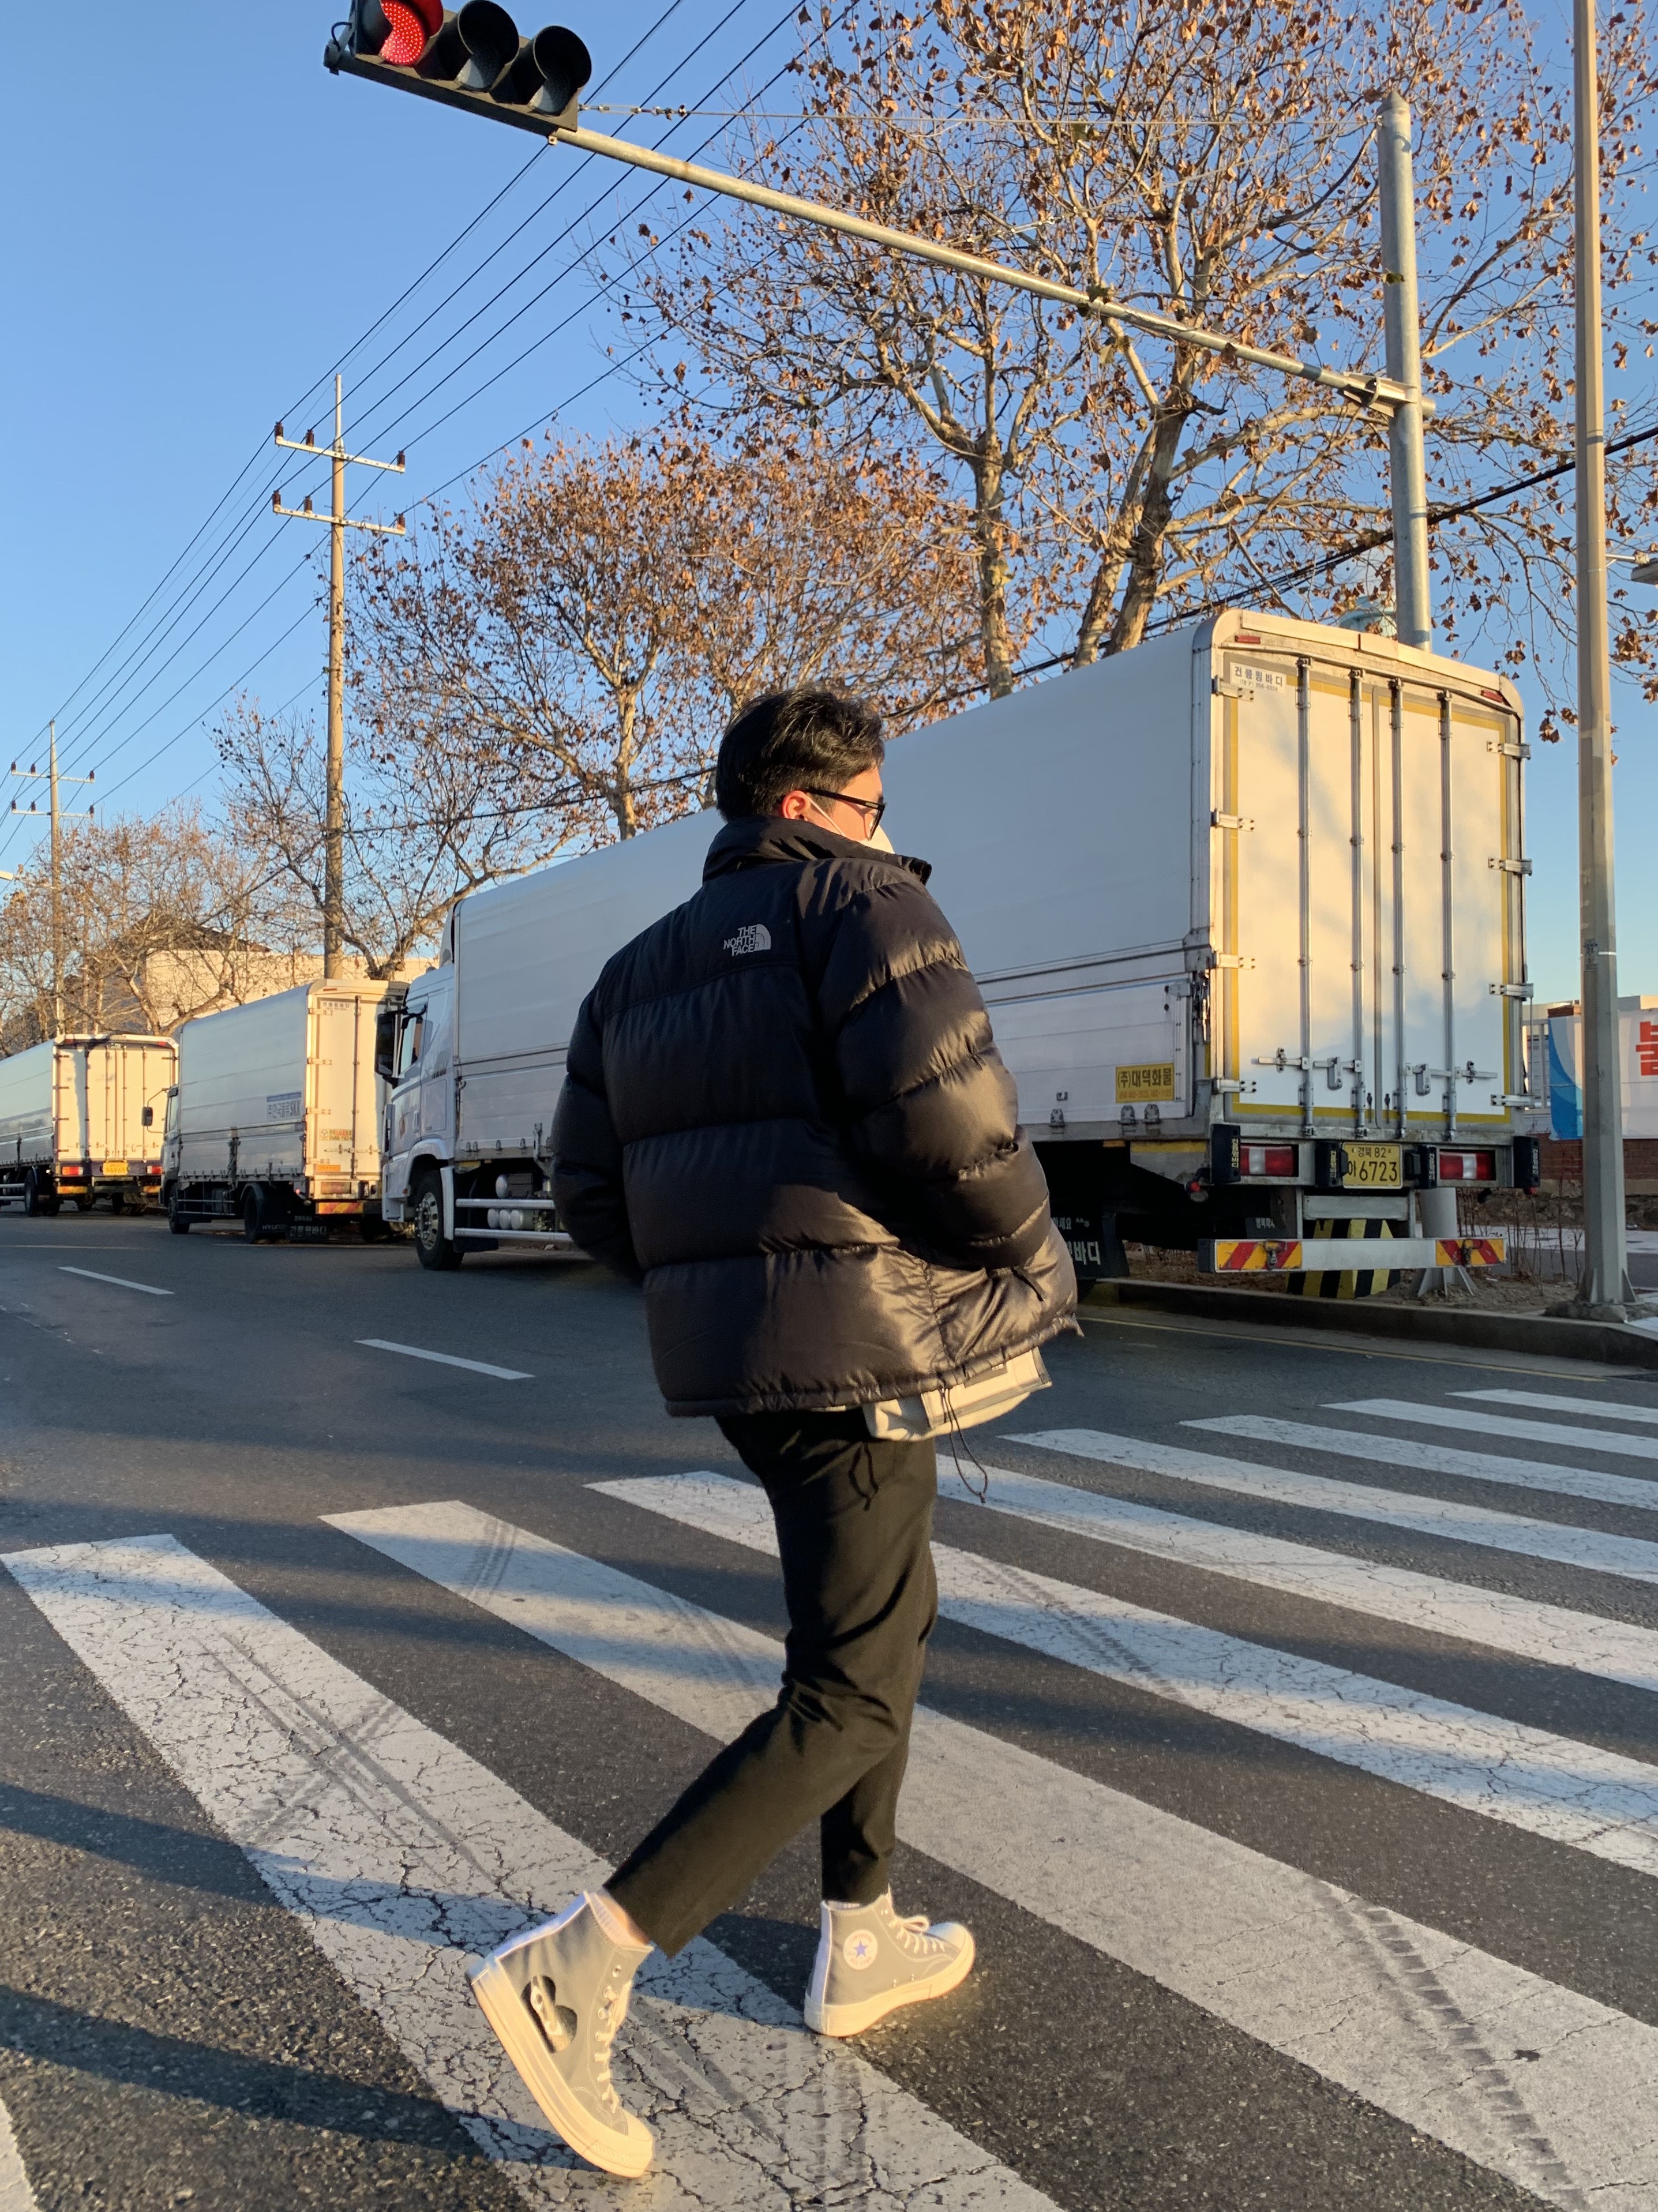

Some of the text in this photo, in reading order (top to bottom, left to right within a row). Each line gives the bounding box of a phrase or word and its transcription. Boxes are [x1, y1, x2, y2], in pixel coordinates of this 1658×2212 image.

[738, 925, 757, 937] THE
[723, 934, 756, 949] NORTH
[731, 944, 755, 956] FACE
[1117, 1068, 1172, 1088] (주)대덕화물
[1358, 1147, 1386, 1158] 경북 82
[1067, 1241, 1101, 1265] 바디
